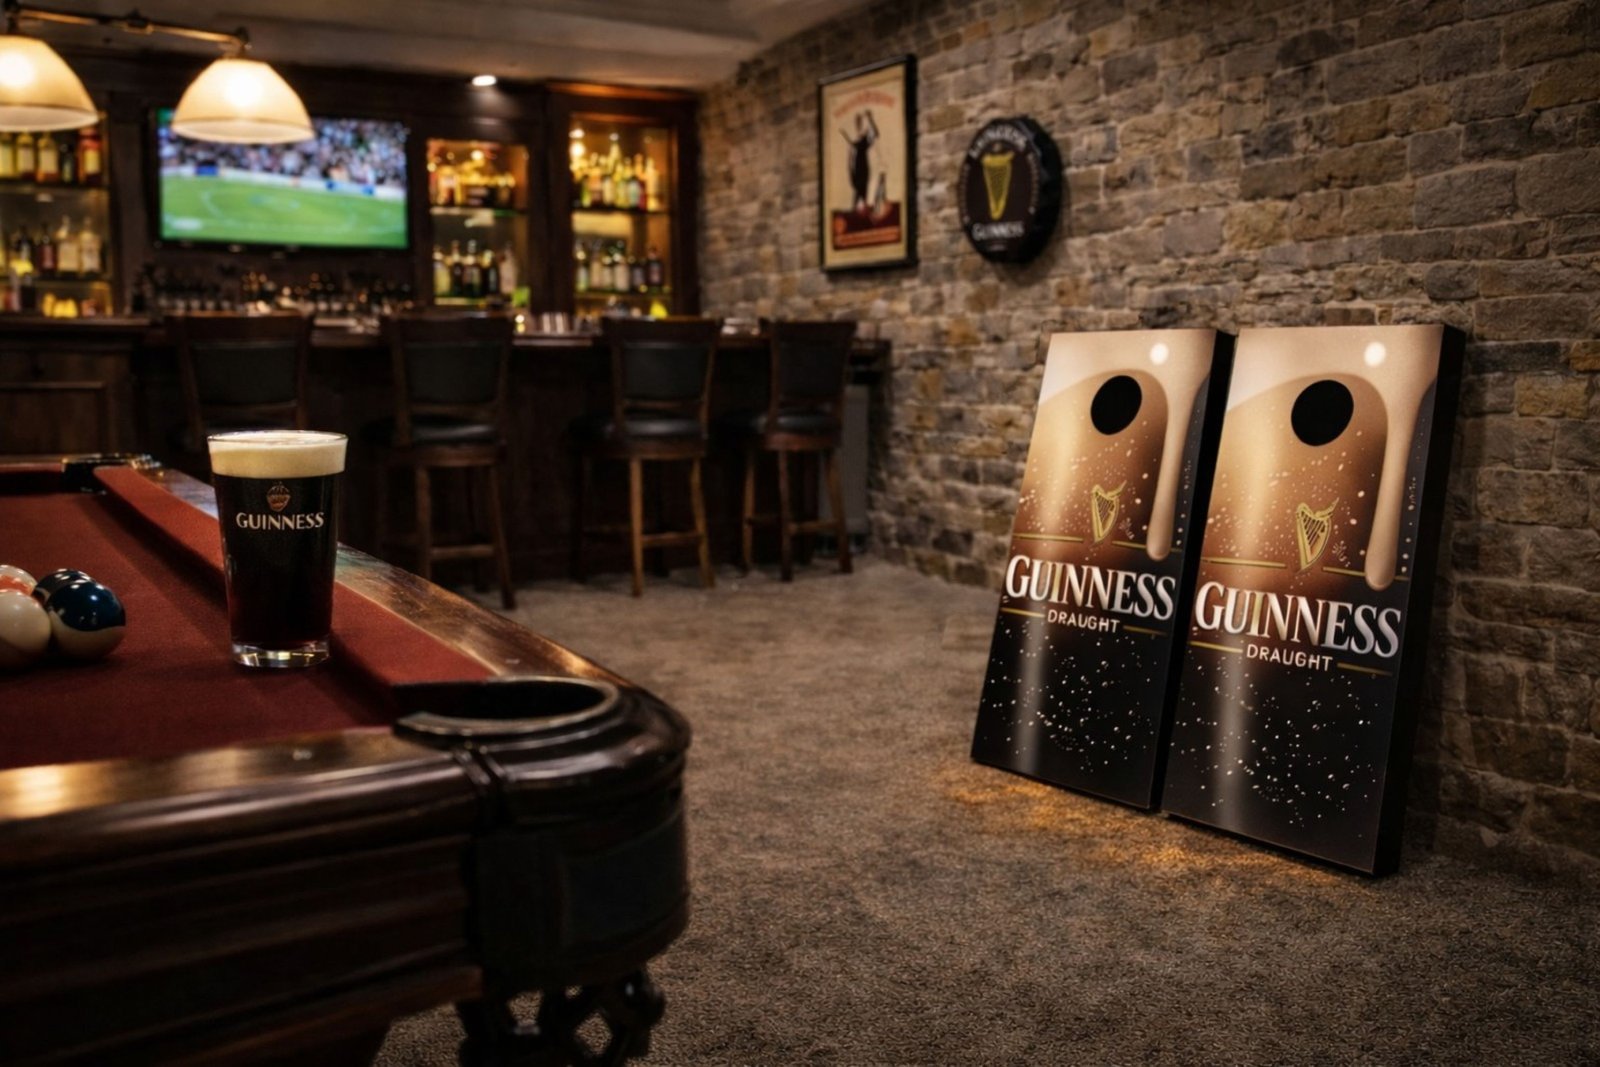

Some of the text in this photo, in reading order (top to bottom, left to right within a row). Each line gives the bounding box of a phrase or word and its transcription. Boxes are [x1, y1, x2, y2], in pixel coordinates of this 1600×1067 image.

[236, 512, 324, 530] GUINNESS
[1005, 555, 1176, 621] GUINNESS
[1047, 609, 1120, 633] DRAUGHT
[1195, 581, 1401, 658] GUINNESS
[1246, 643, 1333, 671] DRAUGHT
